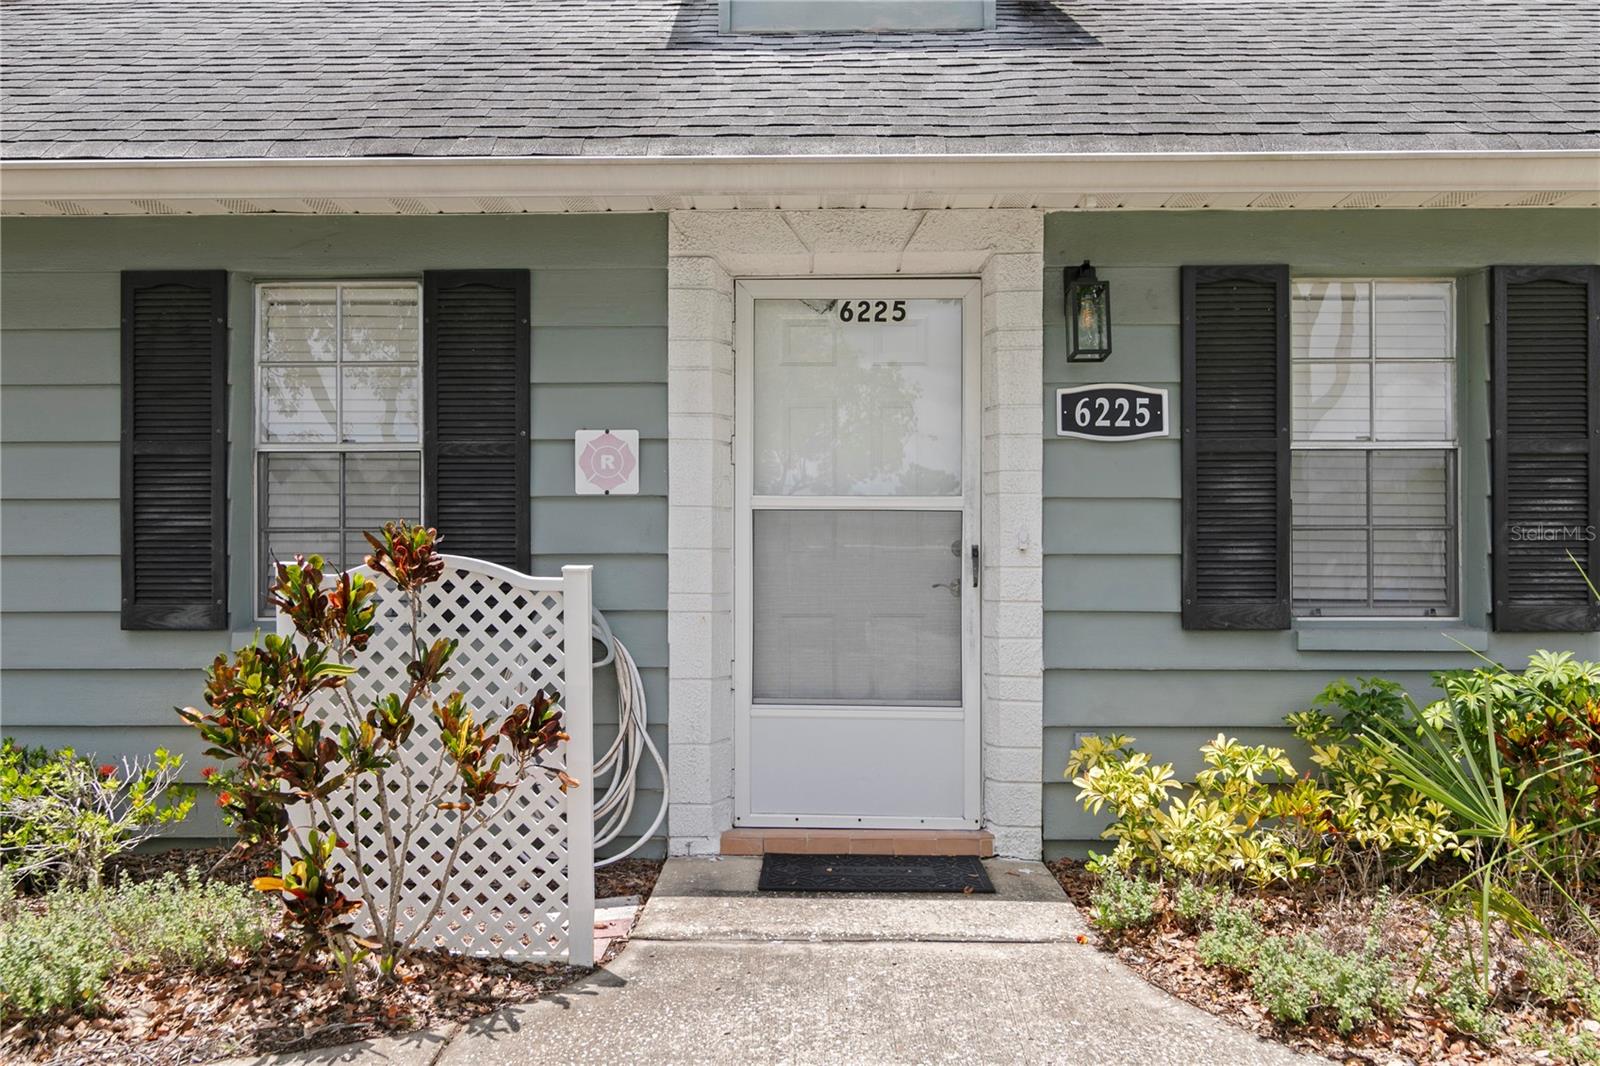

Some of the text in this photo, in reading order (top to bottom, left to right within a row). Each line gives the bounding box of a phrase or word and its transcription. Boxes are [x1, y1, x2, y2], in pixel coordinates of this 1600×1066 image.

[840, 301, 906, 322] 6225
[1074, 397, 1151, 427] 6225
[600, 454, 615, 470] R
